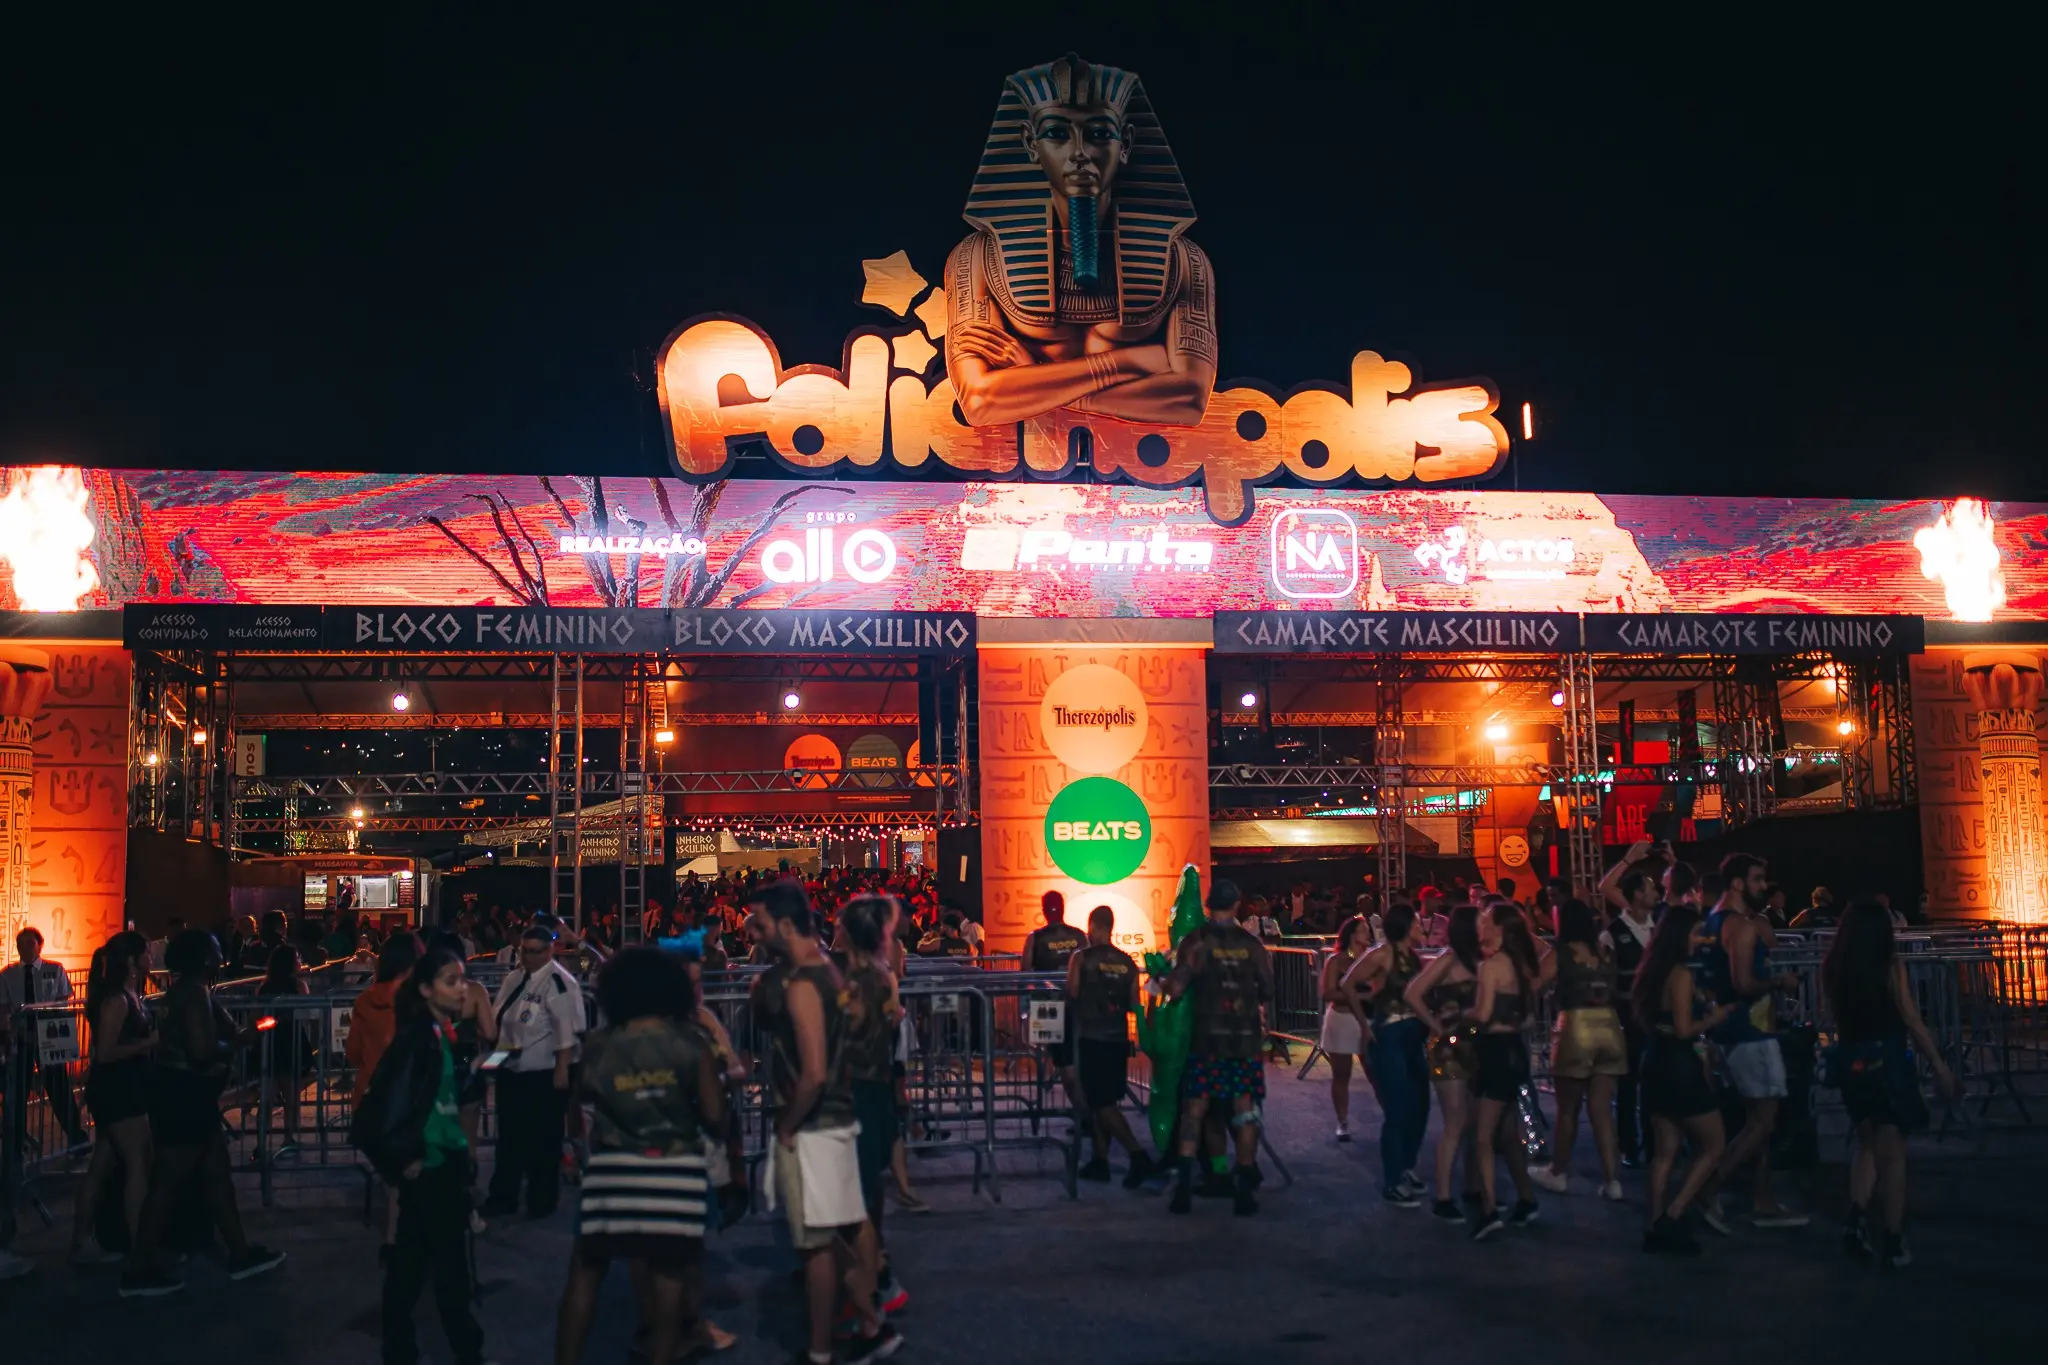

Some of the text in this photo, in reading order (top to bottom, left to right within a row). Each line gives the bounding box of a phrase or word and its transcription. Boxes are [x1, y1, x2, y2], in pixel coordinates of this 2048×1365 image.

[806, 512, 857, 524] grupo
[1018, 531, 1214, 566] Panta
[1285, 531, 1347, 571] NA
[1477, 538, 1576, 564] ACTOS
[151, 613, 197, 626] ACESSO
[255, 616, 292, 627] ACESSO
[138, 627, 209, 641] CONVIDADO
[228, 627, 318, 639] RELACIONAMENTO
[355, 612, 636, 646] BLOCO FEMININO
[674, 615, 970, 650] BLOCO MASCULINO
[1236, 617, 1561, 648] CAMAROTE MASCULINO
[1617, 619, 1894, 649] CAMAROTE FEMININO
[851, 757, 897, 768] BEATS
[1053, 821, 1142, 841] BEATS
[581, 837, 620, 847] ANHEIRO
[580, 847, 618, 857] EMININO
